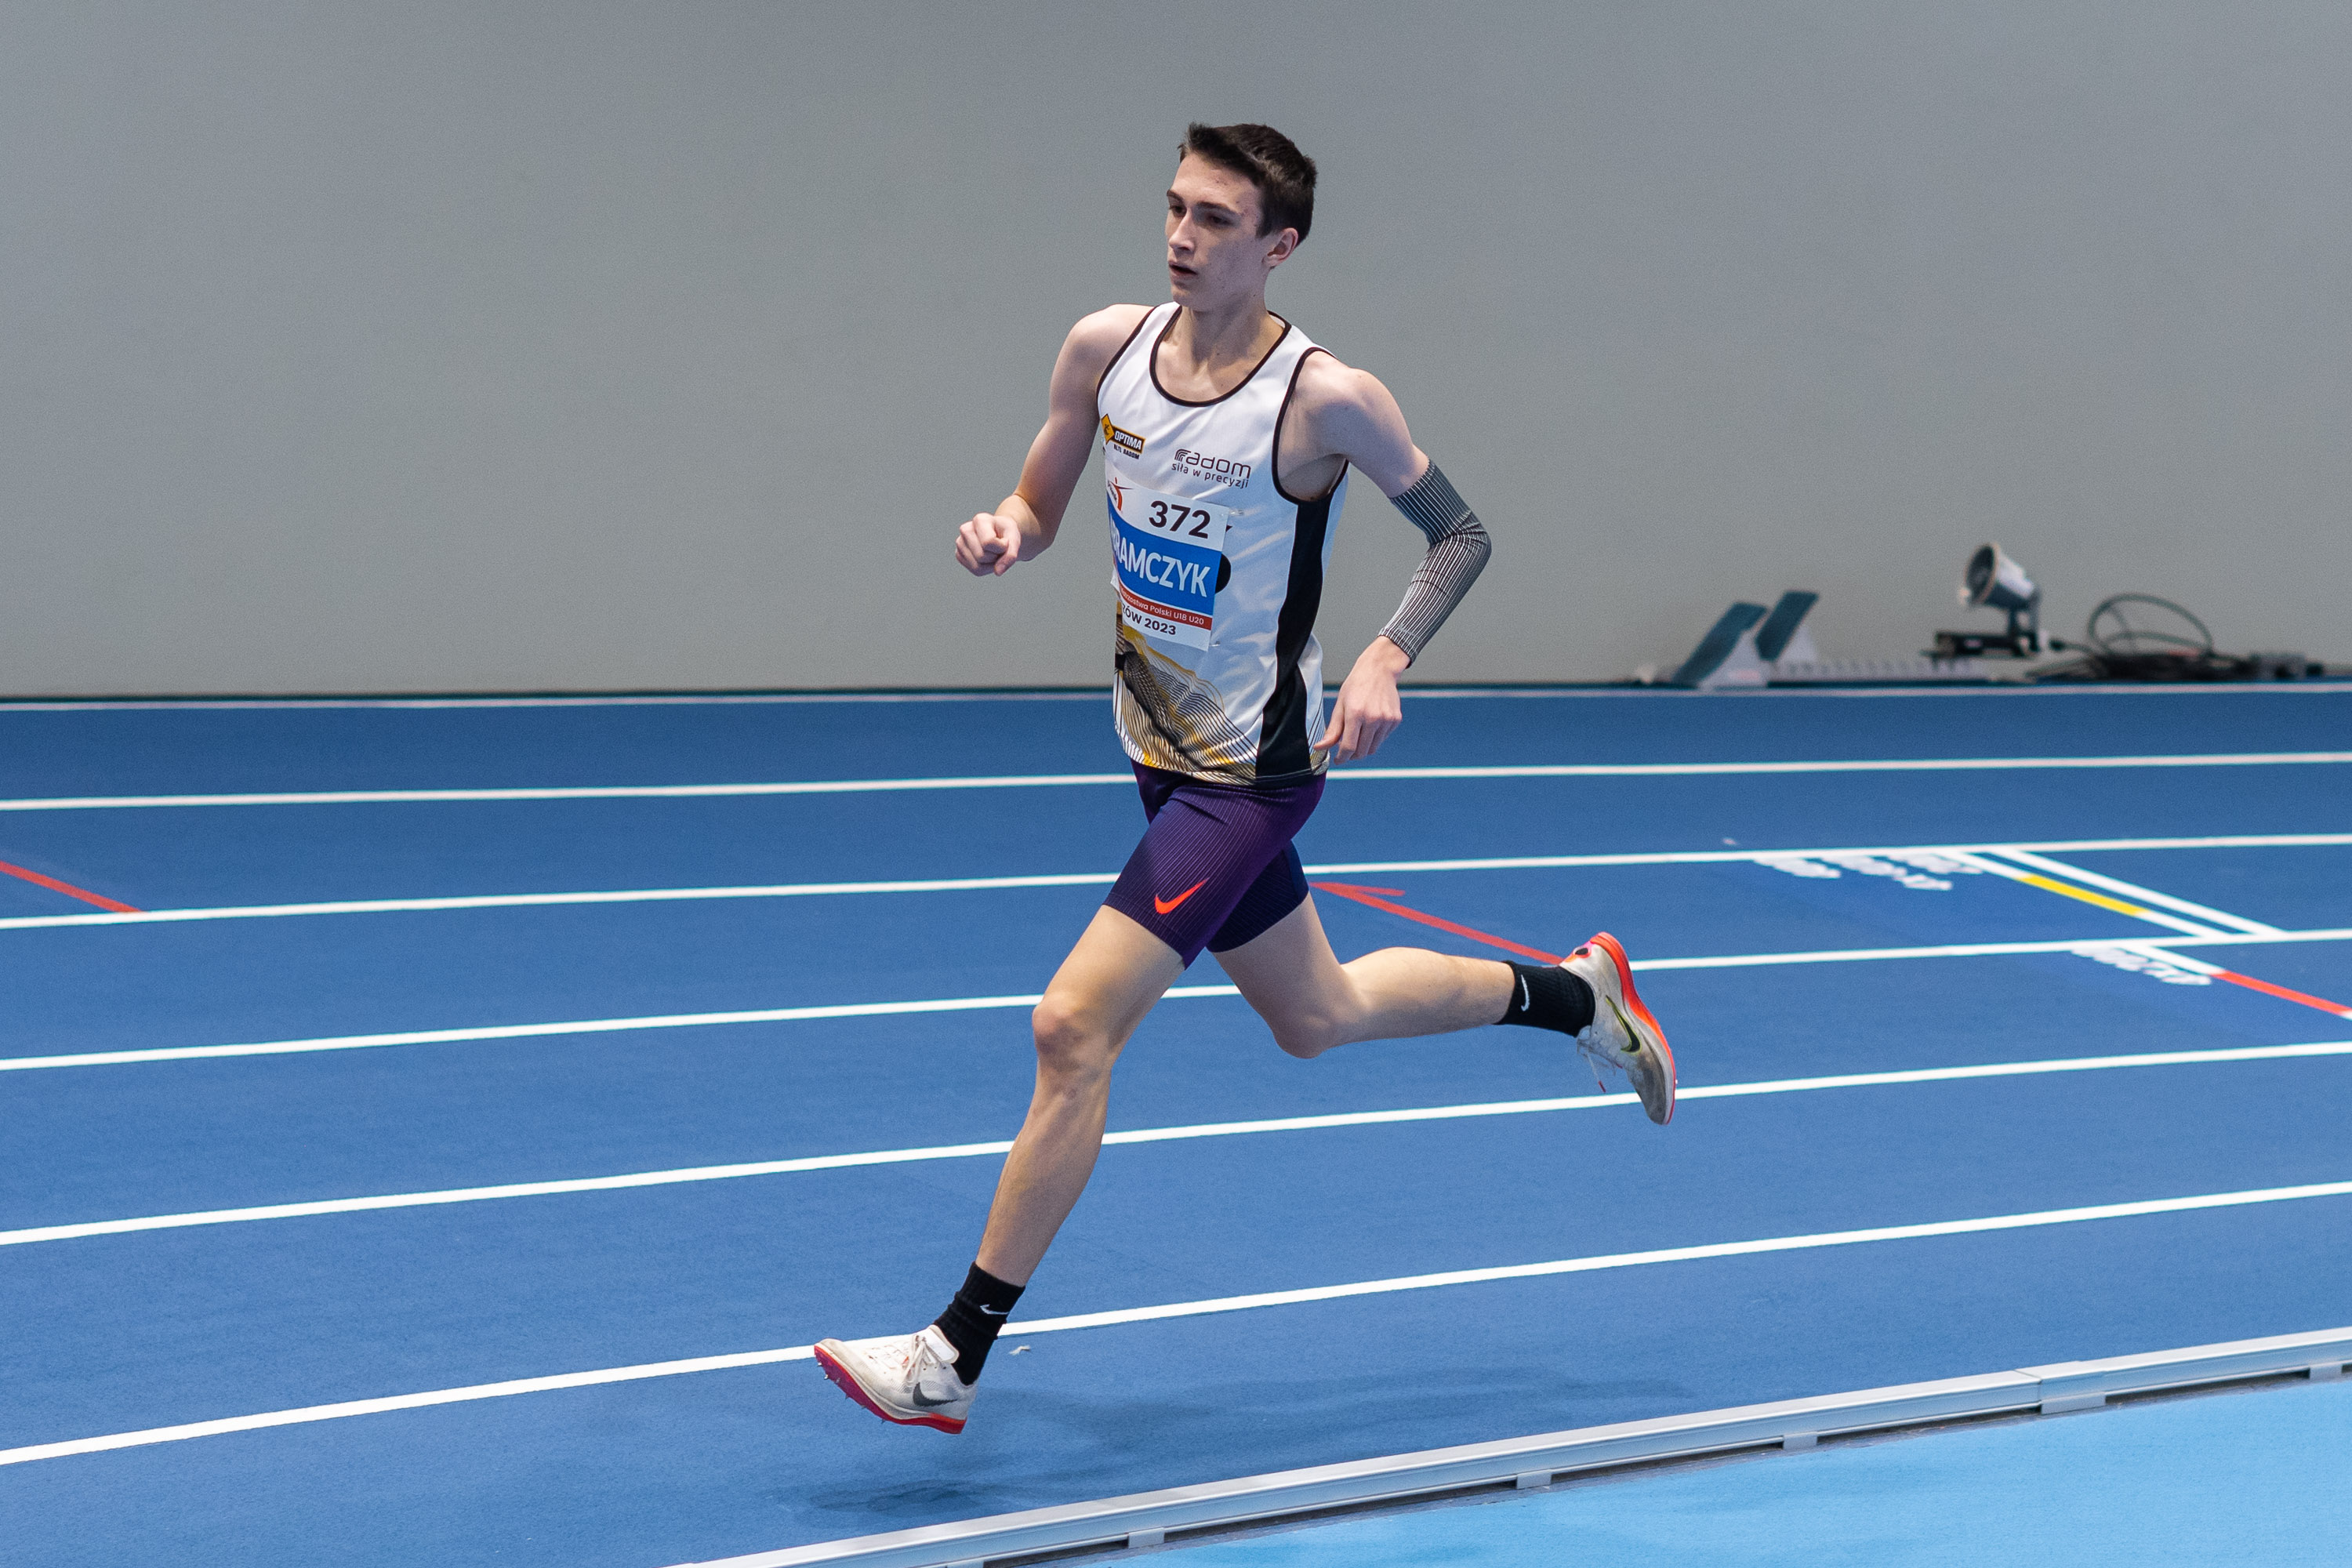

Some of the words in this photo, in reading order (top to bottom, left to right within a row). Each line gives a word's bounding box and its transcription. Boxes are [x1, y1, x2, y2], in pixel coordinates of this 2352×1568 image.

[1114, 430, 1142, 450] OPTIMA
[1171, 463, 1189, 474] siła
[1204, 472, 1250, 489] precyzji
[1149, 501, 1210, 539] 372
[1150, 605, 1172, 617] Polski
[1174, 612, 1187, 621] U18
[1189, 615, 1204, 625] U20
[1144, 618, 1176, 635] 2023
